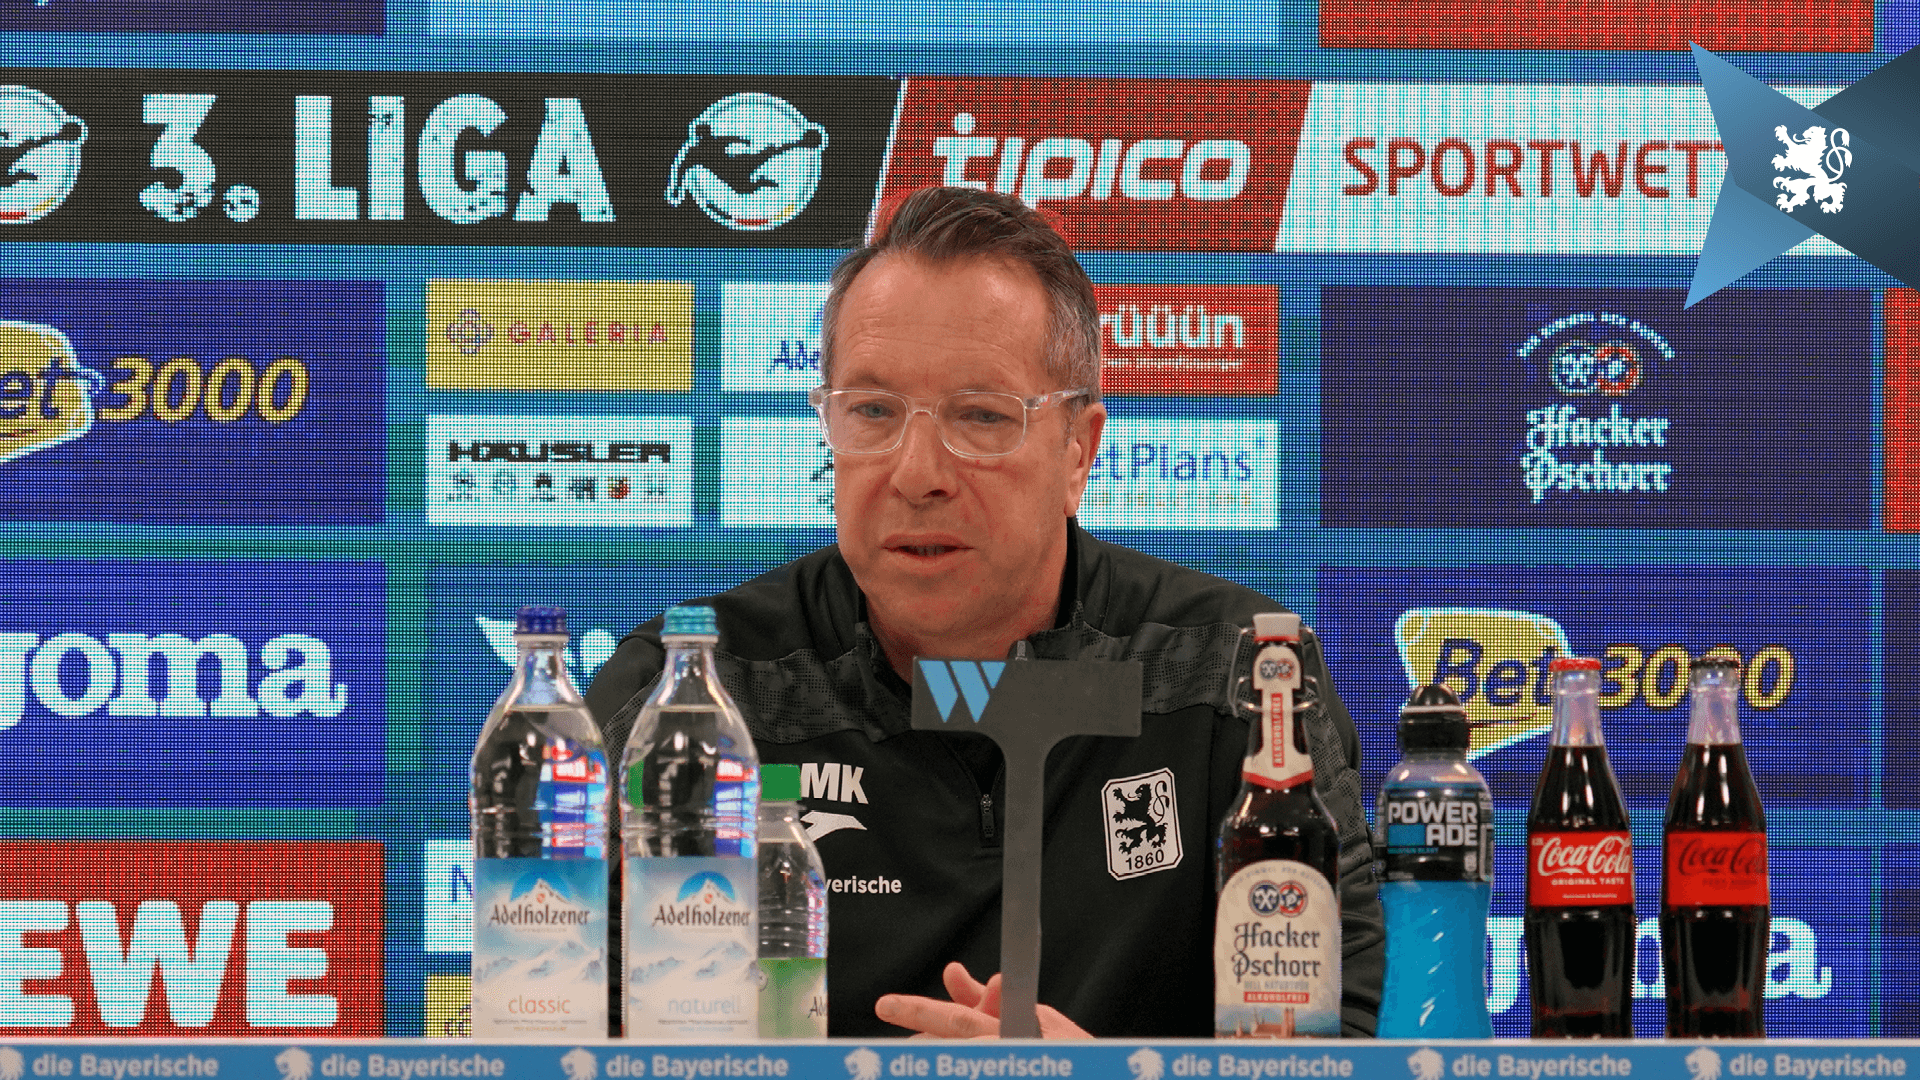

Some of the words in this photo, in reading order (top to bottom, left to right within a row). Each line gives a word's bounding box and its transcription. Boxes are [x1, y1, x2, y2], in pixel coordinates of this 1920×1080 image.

[139, 93, 260, 222] 3.
[295, 93, 616, 224] LIGA
[933, 112, 1251, 209] tipico
[508, 320, 668, 345] GALERIA
[97, 354, 310, 423] 3000
[1526, 404, 1671, 450] Hacker
[1600, 643, 1798, 709] 300
[800, 762, 869, 805] MK
[1388, 801, 1478, 824] POWER
[1426, 824, 1478, 847] ADE
[1125, 849, 1165, 871] 1860
[1538, 836, 1632, 876] Coca-Cola
[490, 904, 591, 928] Adelholzener
[652, 904, 751, 927] Adelholzener
[1234, 921, 1321, 952] Hacker
[1231, 951, 1322, 984] Pschorr
[508, 994, 571, 1014] classic
[668, 996, 741, 1014] naturell
[32, 1054, 73, 1077] die
[80, 1054, 219, 1080] Bayerische
[321, 1054, 361, 1077] die
[367, 1054, 505, 1080] Bayerische
[605, 1054, 645, 1077] die
[652, 1054, 789, 1080] Bayerische
[890, 1054, 929, 1077] die
[936, 1054, 1073, 1080] Bayerische
[1172, 1054, 1211, 1077] die
[1218, 1054, 1353, 1080] Bayerische
[1452, 1054, 1491, 1077] die
[1498, 1054, 1632, 1080] Bayerische
[1729, 1054, 1768, 1077] die
[1774, 1054, 1907, 1080] Bayerische
